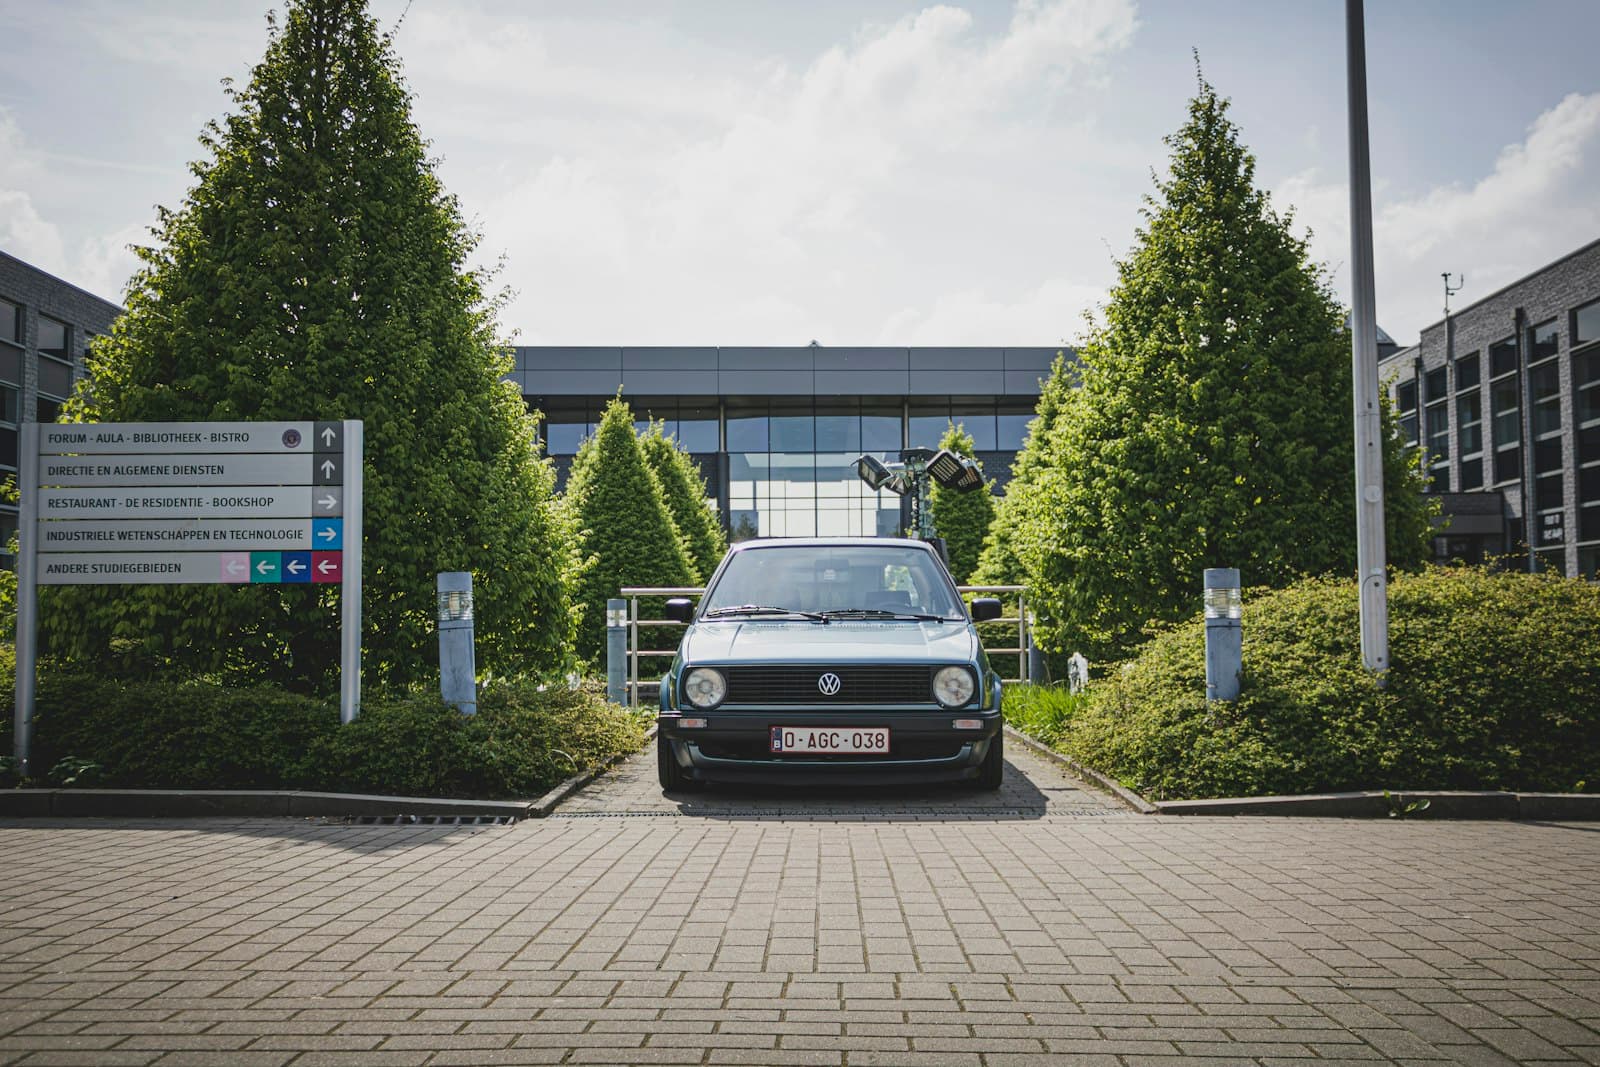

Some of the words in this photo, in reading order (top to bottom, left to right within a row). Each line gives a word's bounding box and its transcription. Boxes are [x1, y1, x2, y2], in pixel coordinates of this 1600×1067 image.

[48, 433, 87, 444] FORUM
[96, 433, 125, 444] AULA
[133, 433, 202, 443] BIBLIOTHEEK
[211, 432, 250, 443] BISTRO
[48, 466, 94, 477] DIRECTIE
[97, 465, 111, 476] EN
[114, 465, 170, 476] ALGEMENE
[173, 464, 225, 475] DIENSTEN
[48, 498, 117, 509] RESTAURANT
[125, 497, 140, 508] DE
[142, 497, 203, 508] RESIDENTIE
[213, 497, 274, 508] BOOKSHOP
[46, 530, 115, 541] INDUSTRIELE
[117, 530, 211, 541] WETENSCHAPPEN
[213, 529, 227, 540] EN
[230, 529, 303, 540] TECHNOLOGIE
[46, 563, 89, 574] ANDERE
[91, 563, 182, 574] STUDIEGEBIEDEN
